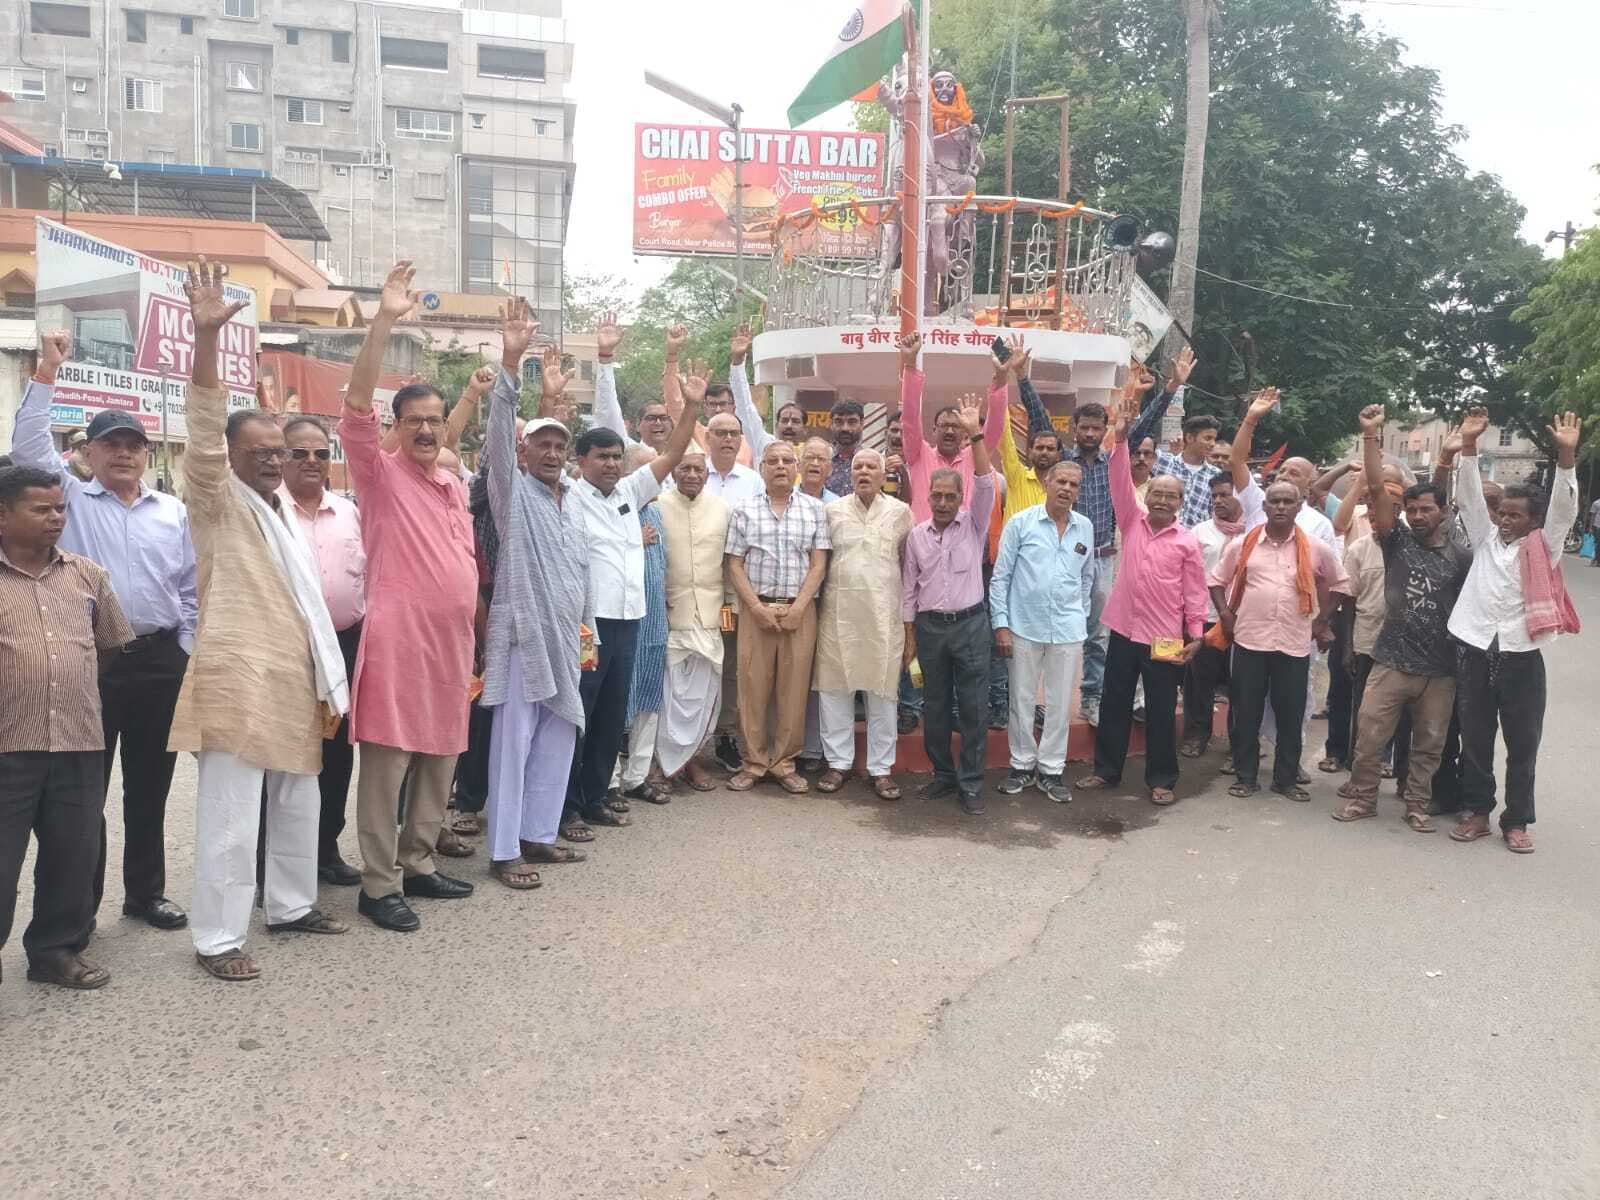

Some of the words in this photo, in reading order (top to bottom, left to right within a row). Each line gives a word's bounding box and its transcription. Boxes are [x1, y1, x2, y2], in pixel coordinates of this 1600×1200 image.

[641, 127, 710, 161] CHAI
[717, 131, 812, 166] SUTTA
[819, 136, 878, 169] BAR
[641, 164, 697, 191] Family
[793, 169, 812, 182] Veg
[638, 190, 676, 209] COMBO
[677, 185, 708, 204] OFFER
[158, 303, 250, 356] MOINI
[840, 331, 864, 350] बाबु
[867, 327, 891, 346] वीर
[931, 328, 961, 346] सिंह
[963, 328, 997, 346] चौक
[158, 338, 252, 386] STES
[57, 366, 94, 385] ARBLE
[103, 372, 132, 390] TILES
[141, 378, 181, 397] GRAITE
[232, 394, 250, 409] BATH
[49, 407, 83, 421] ajaria
